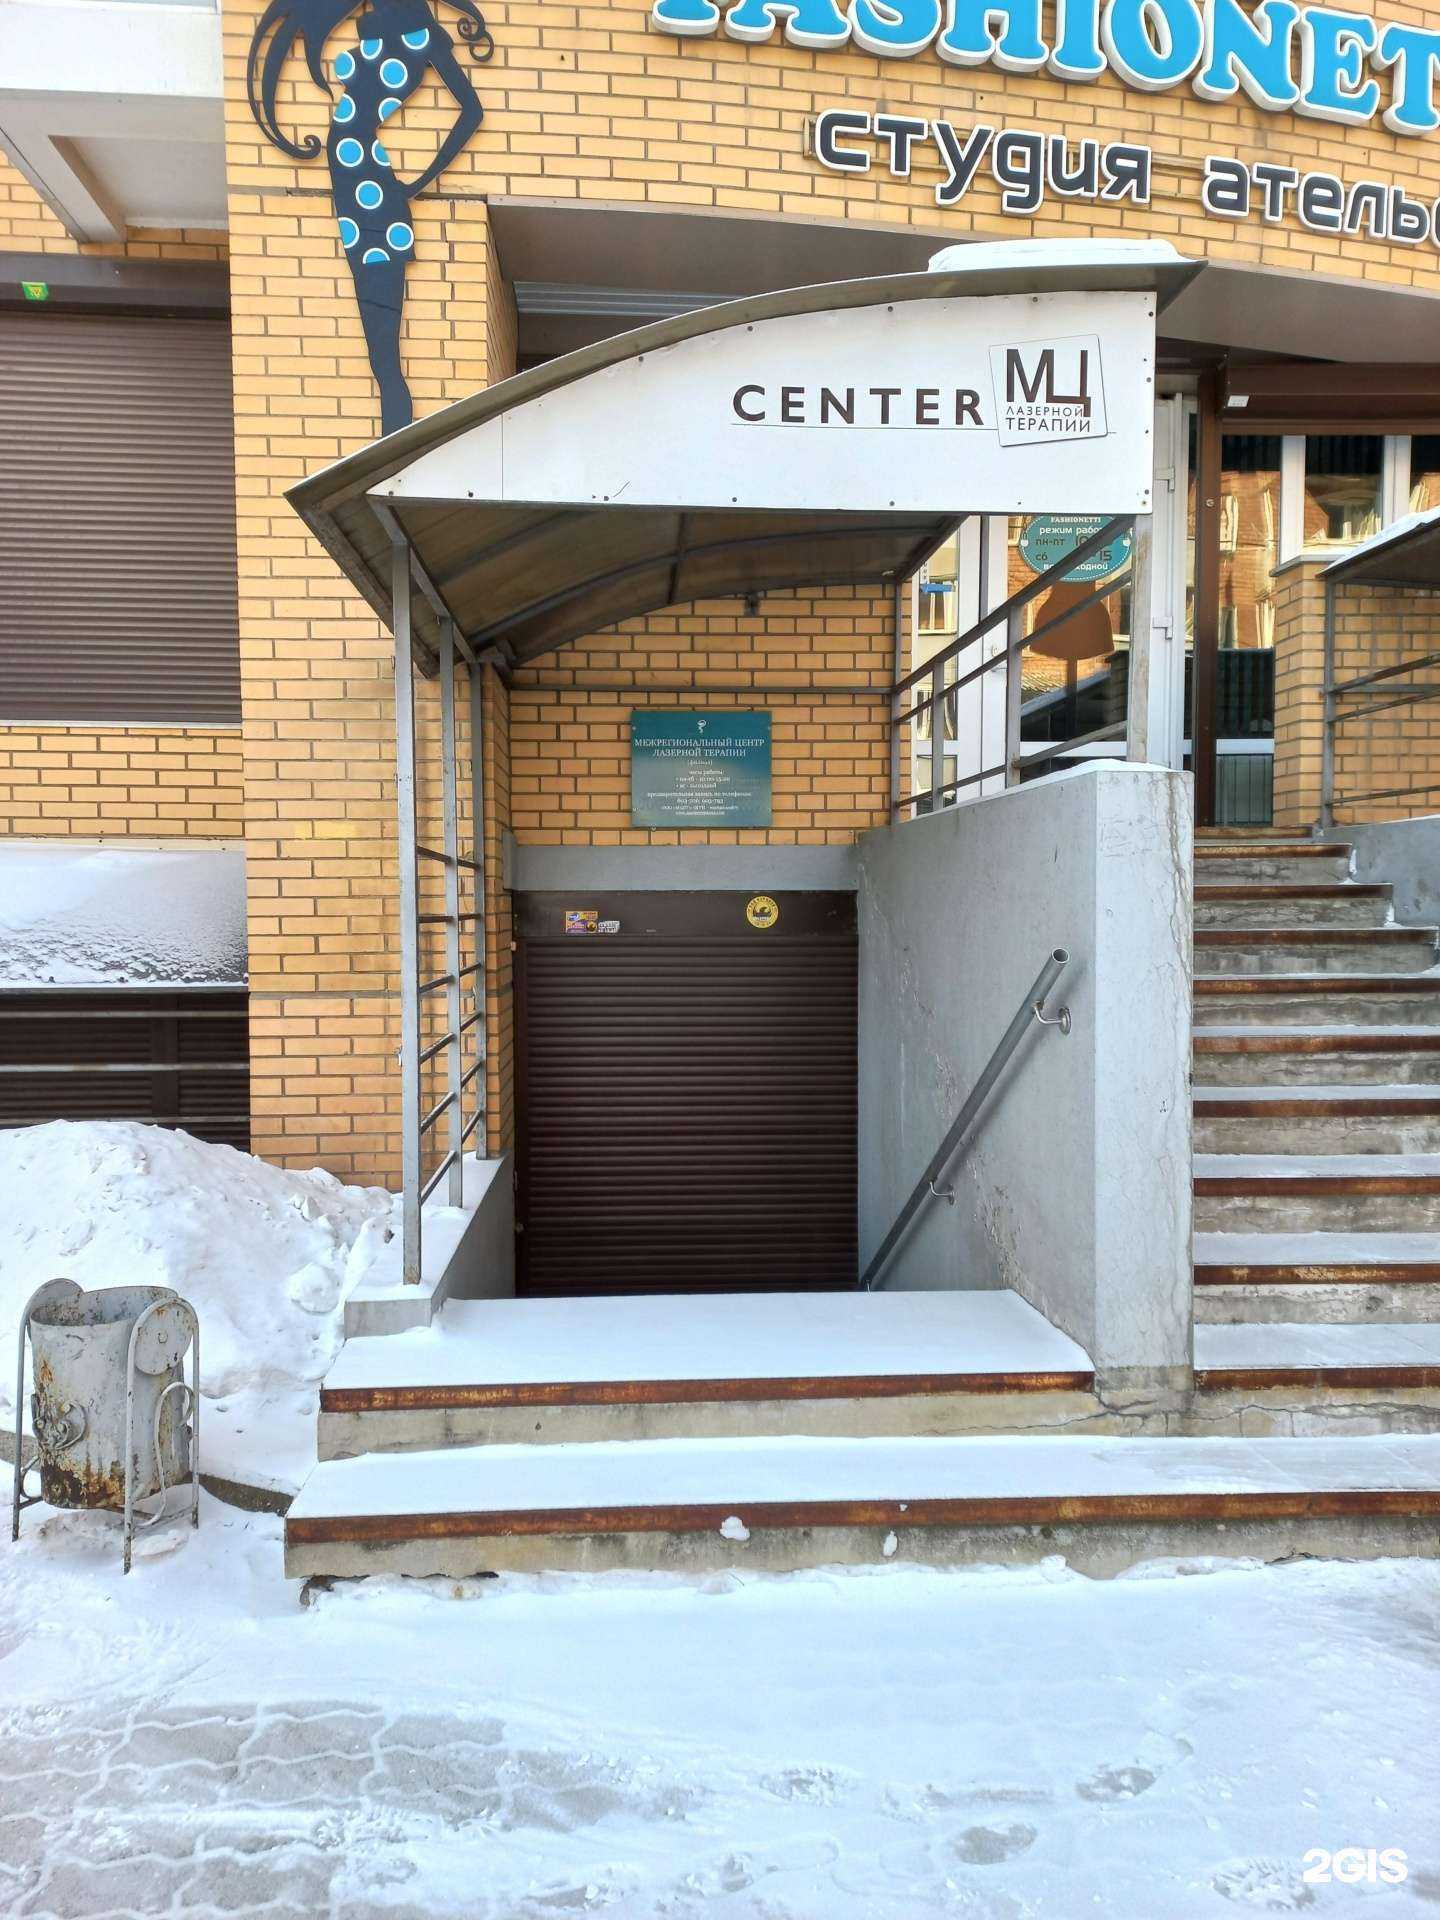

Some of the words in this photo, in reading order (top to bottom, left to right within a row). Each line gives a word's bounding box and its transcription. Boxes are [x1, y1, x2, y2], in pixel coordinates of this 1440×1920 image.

[815, 108, 1151, 214] студия
[1202, 155, 1440, 249] атель
[1006, 348, 1092, 418] МЦ
[732, 384, 984, 426] CENTER
[1006, 405, 1083, 418] ЛАЗЕРНОЙ
[1005, 417, 1091, 433] ТЕРАПИИ
[1040, 527, 1072, 535] режим
[1076, 525, 1102, 535] рабо
[1036, 551, 1048, 561] сб
[634, 738, 732, 748] МЕЖРЕГИОНАЛЬНЫЙ
[735, 739, 765, 749] ЦЕНТР
[653, 748, 702, 757] ЛАЗЕРНОЙ
[704, 748, 746, 757] ТЕРАПИИ
